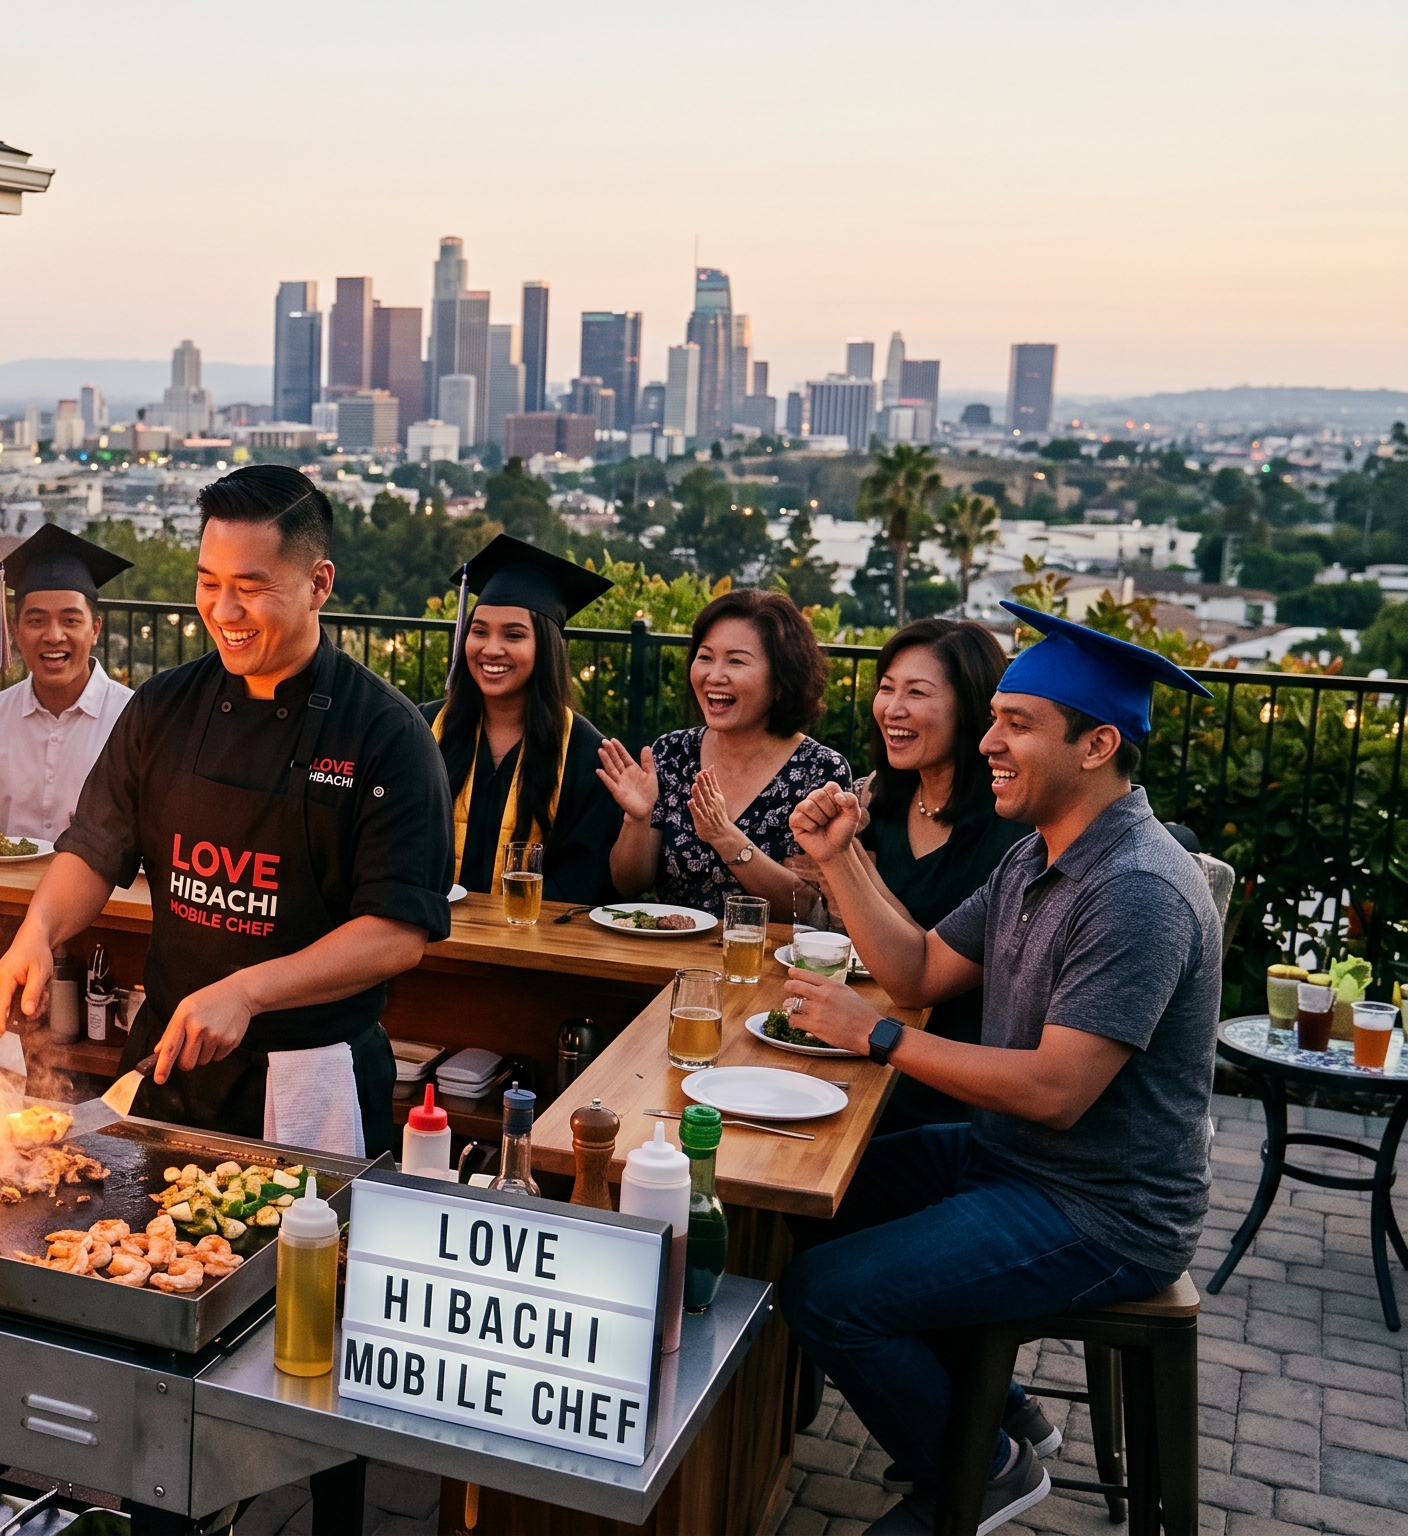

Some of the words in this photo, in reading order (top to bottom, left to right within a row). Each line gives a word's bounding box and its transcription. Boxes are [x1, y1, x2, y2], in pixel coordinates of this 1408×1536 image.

[312, 757, 355, 776] LOVE
[172, 833, 281, 890] LOVE
[170, 871, 278, 917] HIBACHI
[170, 898, 222, 929] MOBILE
[225, 916, 275, 937] CHEF
[438, 1213, 559, 1281] LOVE
[384, 1275, 599, 1364] HIBACHI
[344, 1338, 507, 1416] MOBILE
[531, 1380, 640, 1444] CHEF
